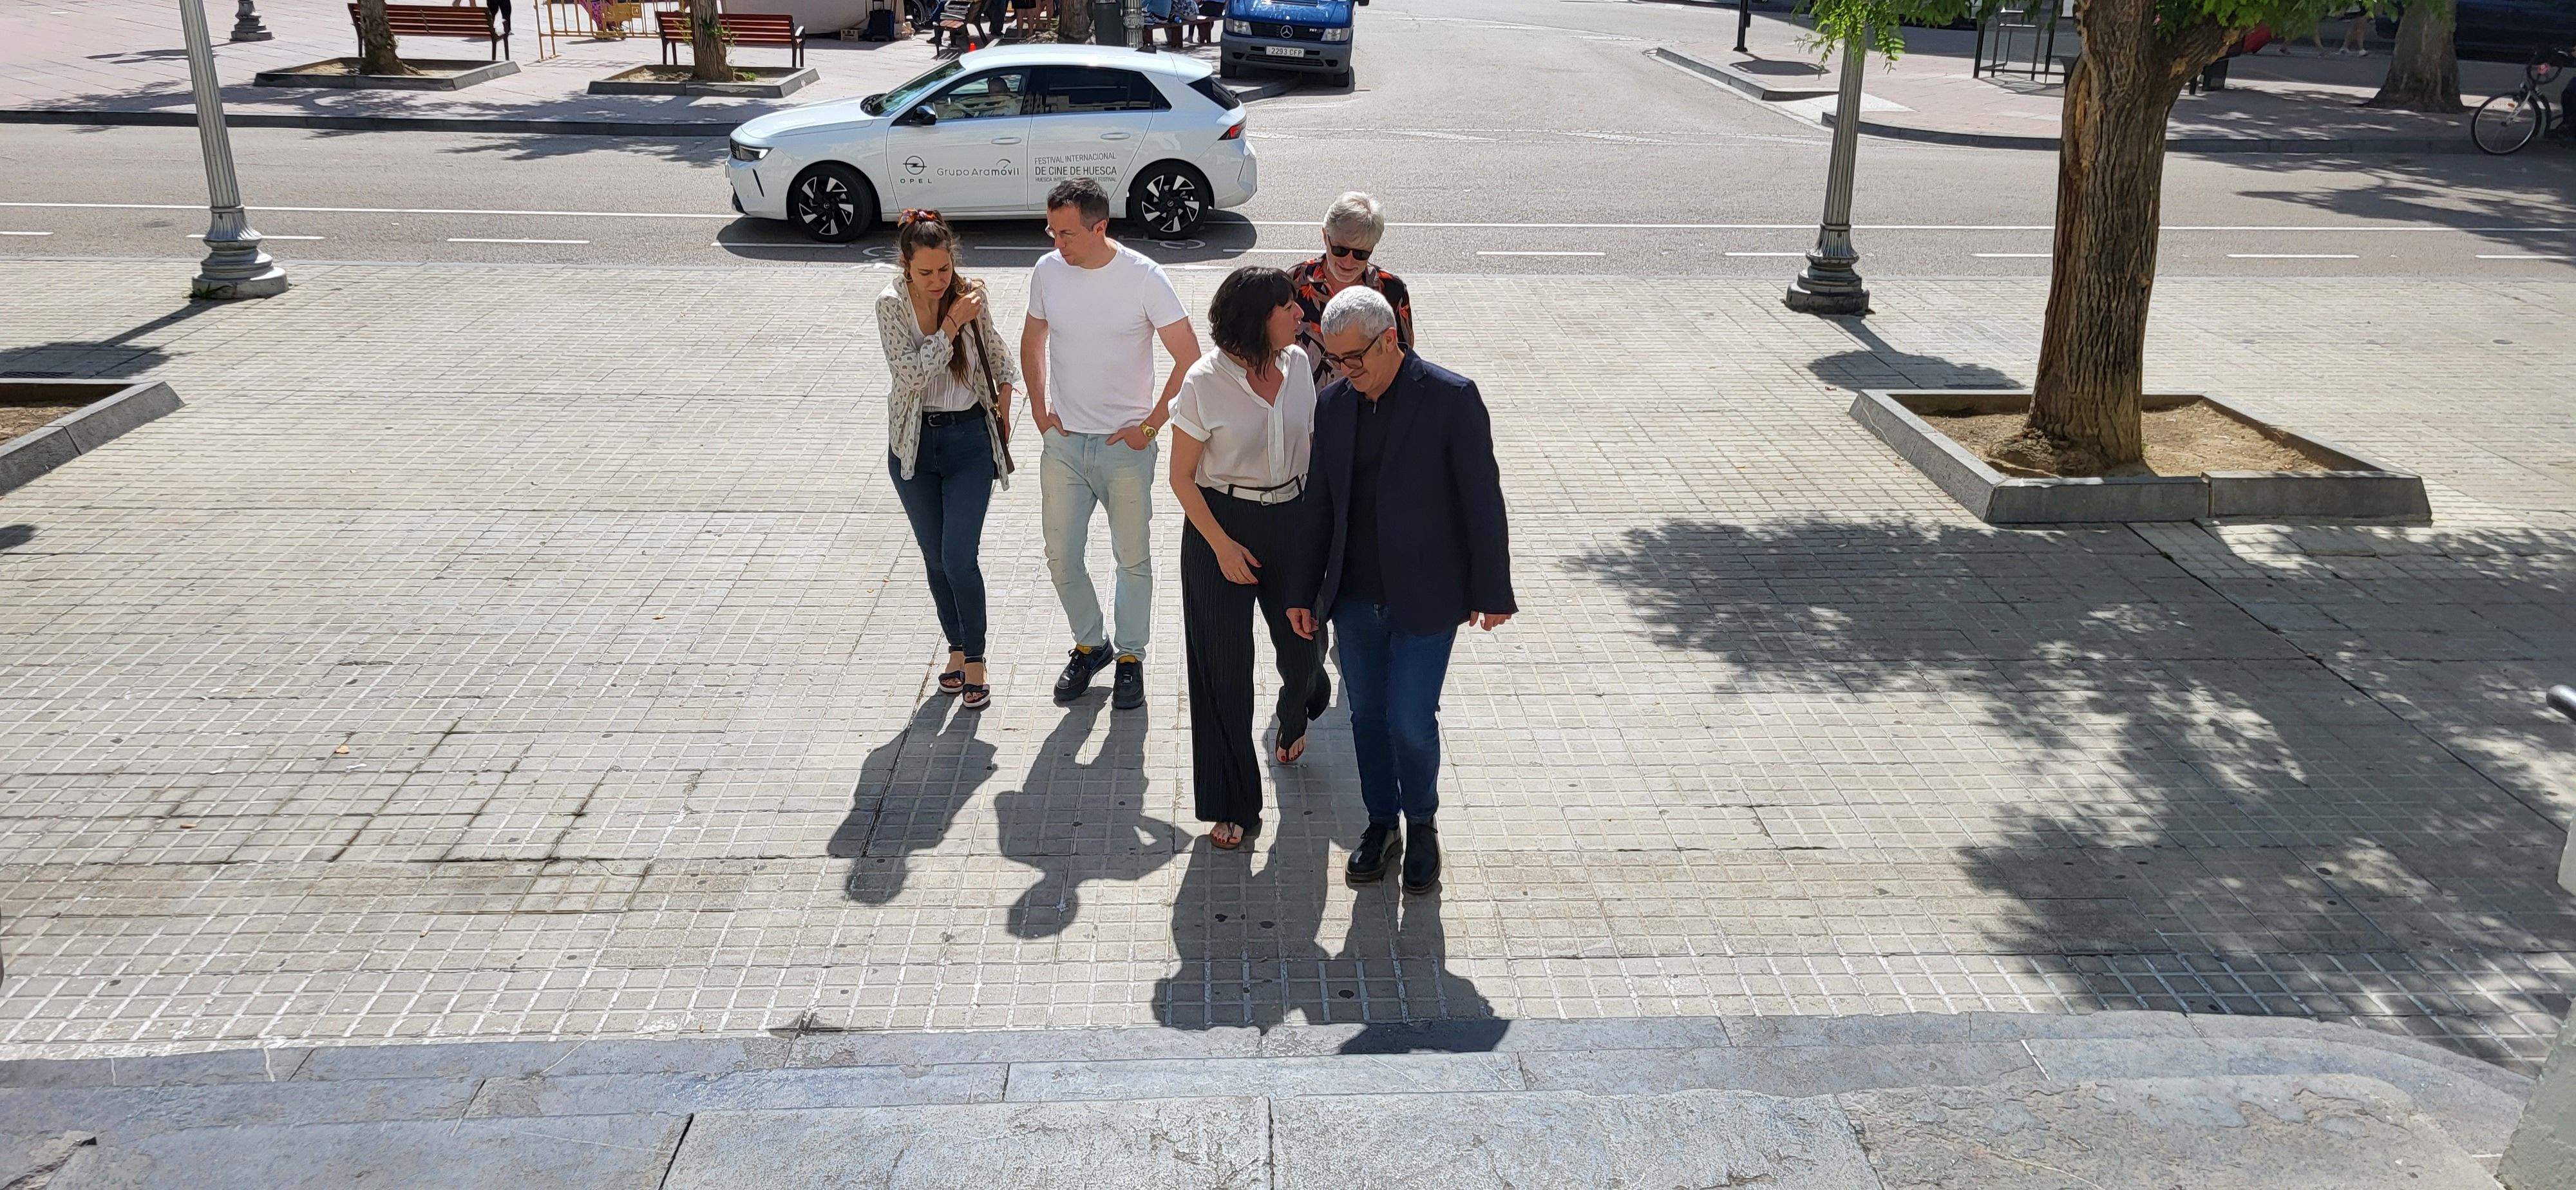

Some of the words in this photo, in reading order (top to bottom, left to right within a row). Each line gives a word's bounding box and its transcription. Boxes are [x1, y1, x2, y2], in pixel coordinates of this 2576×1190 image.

[1271, 47, 1287, 55] 2293
[1034, 156, 1064, 165] FESTIVAL
[1065, 152, 1117, 162] INTERNACIONAL
[936, 167, 970, 177] Grupo
[1035, 166, 1046, 175] DE
[1048, 166, 1068, 175] CINE
[1070, 166, 1081, 175] DE
[1083, 166, 1117, 175] HUESCA
